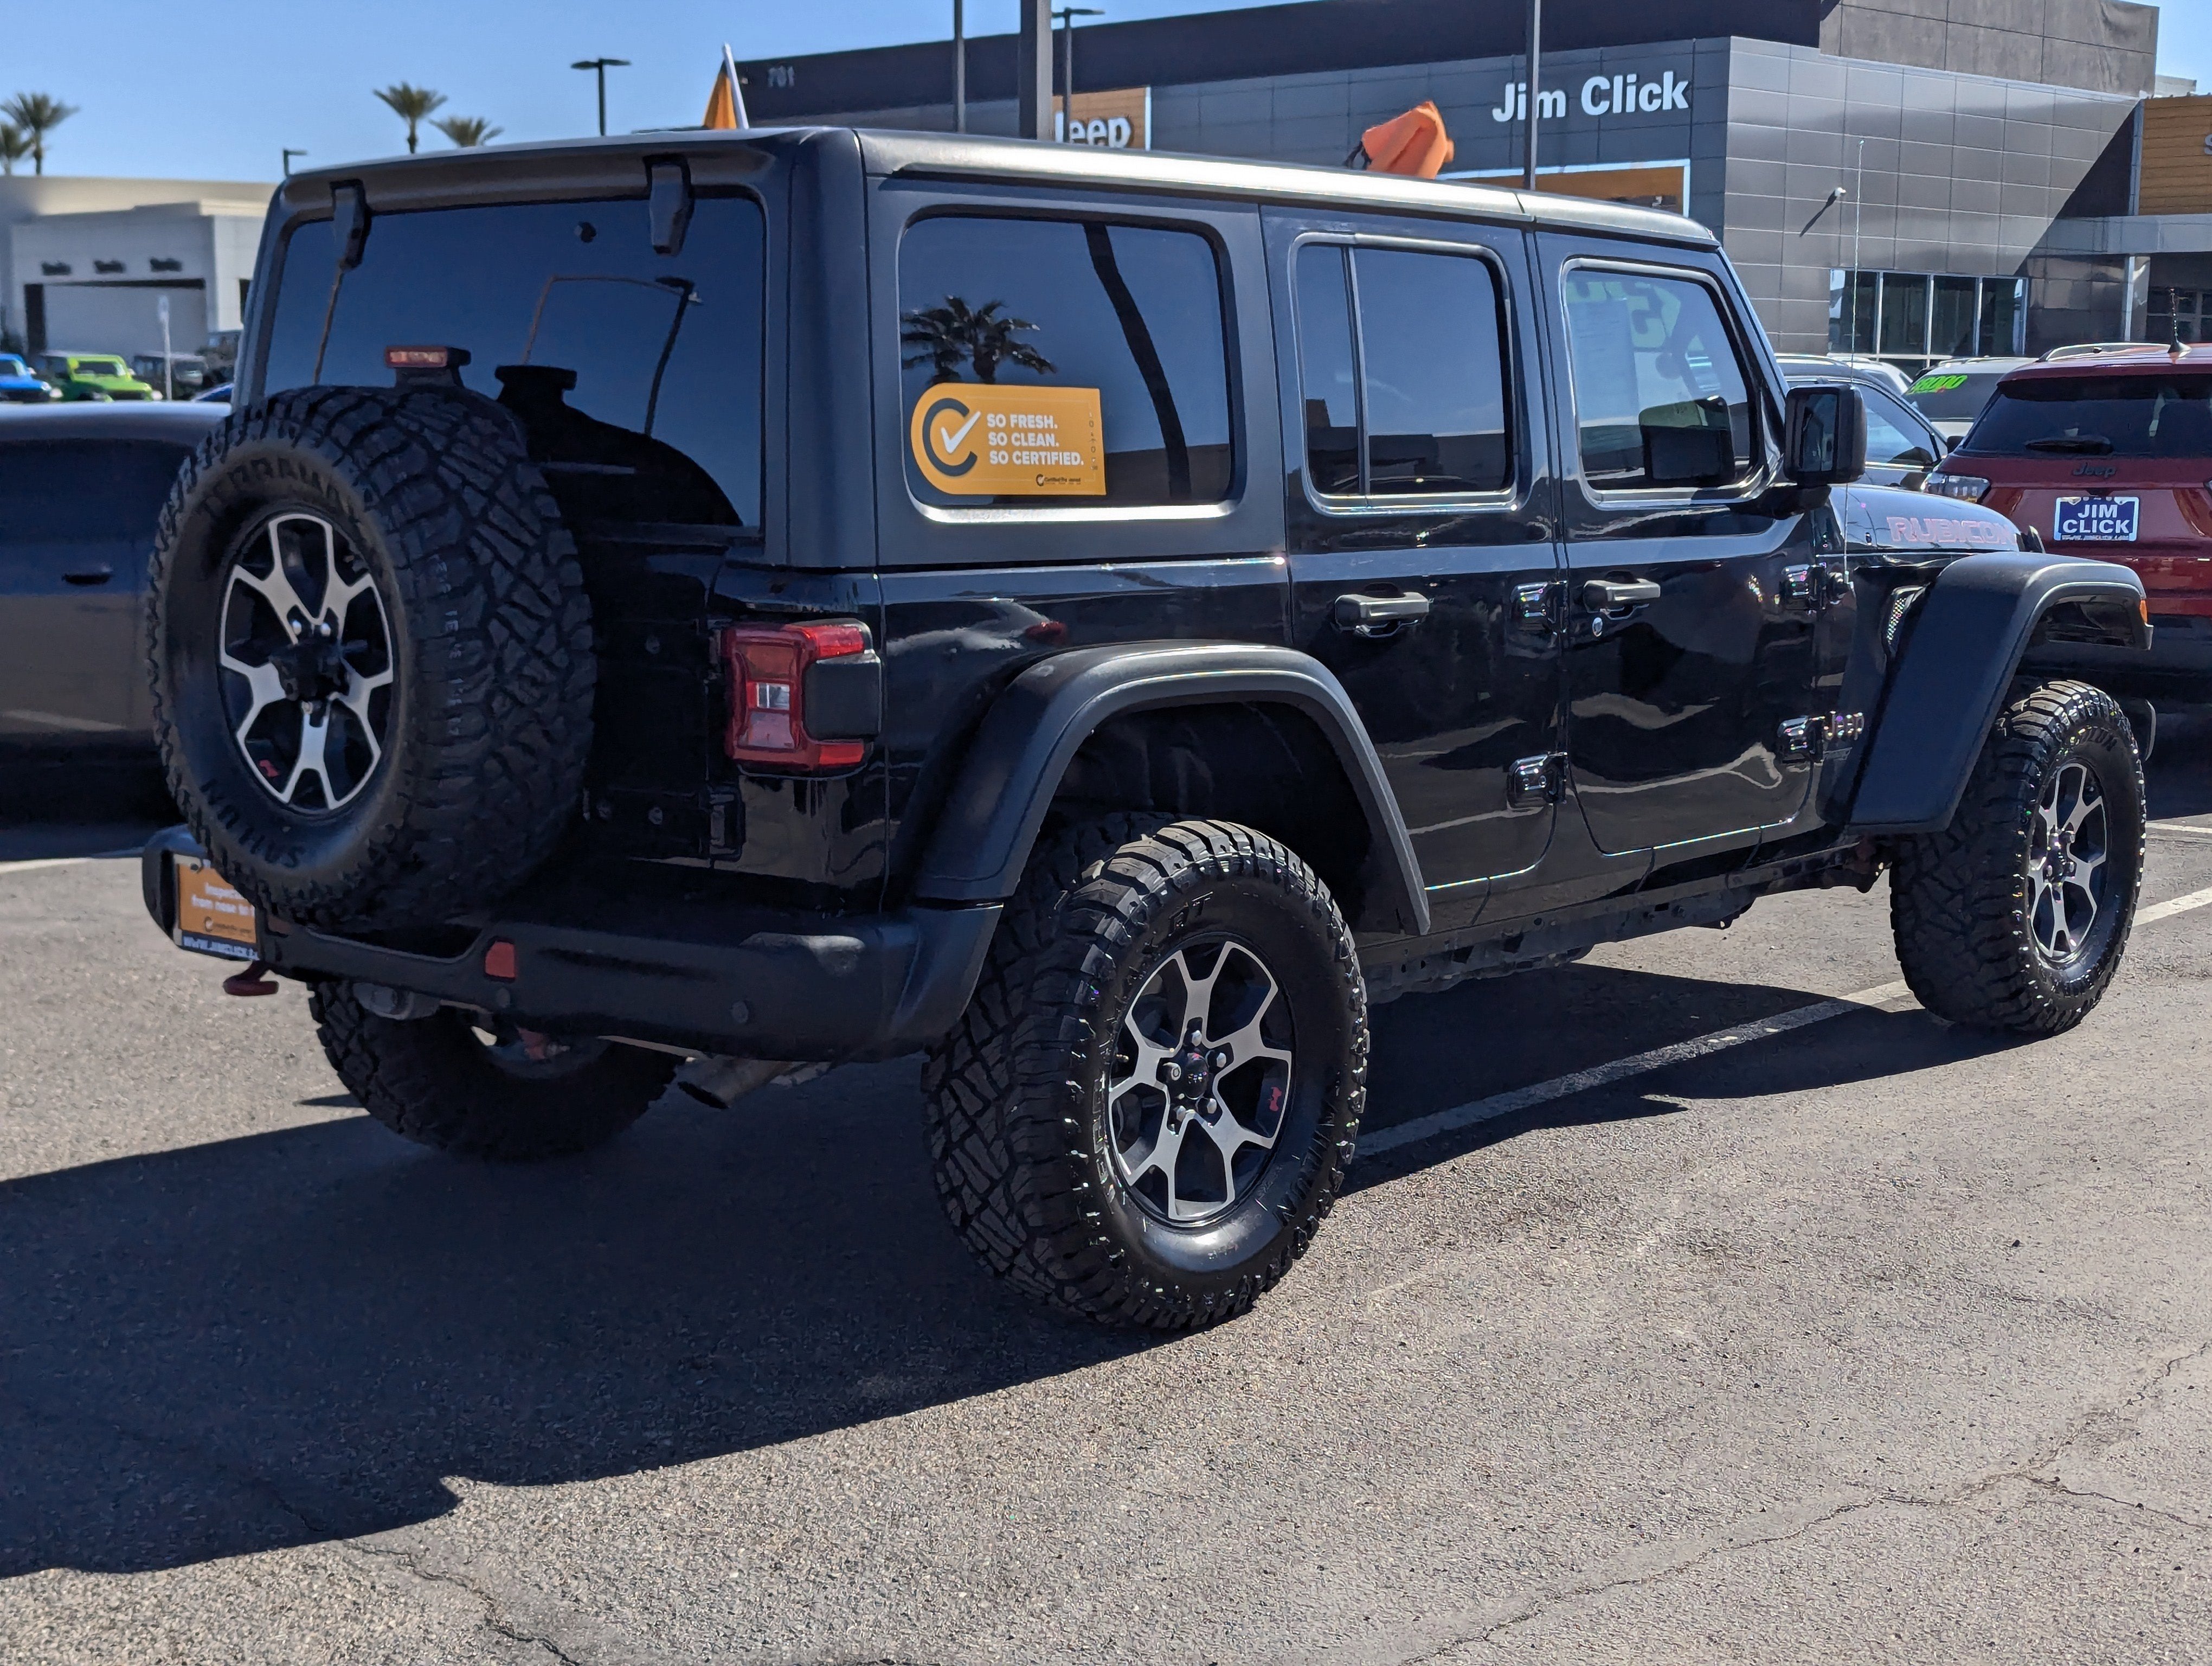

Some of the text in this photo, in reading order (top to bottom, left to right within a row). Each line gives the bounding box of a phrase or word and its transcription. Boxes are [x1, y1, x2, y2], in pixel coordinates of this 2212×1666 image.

[1491, 71, 1689, 123] Jim Click
[987, 413, 1058, 429] SO FRESH.
[988, 432, 1059, 447] SO CLEAN.
[989, 450, 1084, 466] SO CERTIFIED.
[2072, 462, 2117, 478] Jeep
[2078, 504, 2118, 518] JIM
[1886, 516, 2017, 545] RUBICON
[2062, 519, 2131, 534] CLICK
[1823, 711, 1864, 741] Jeep
